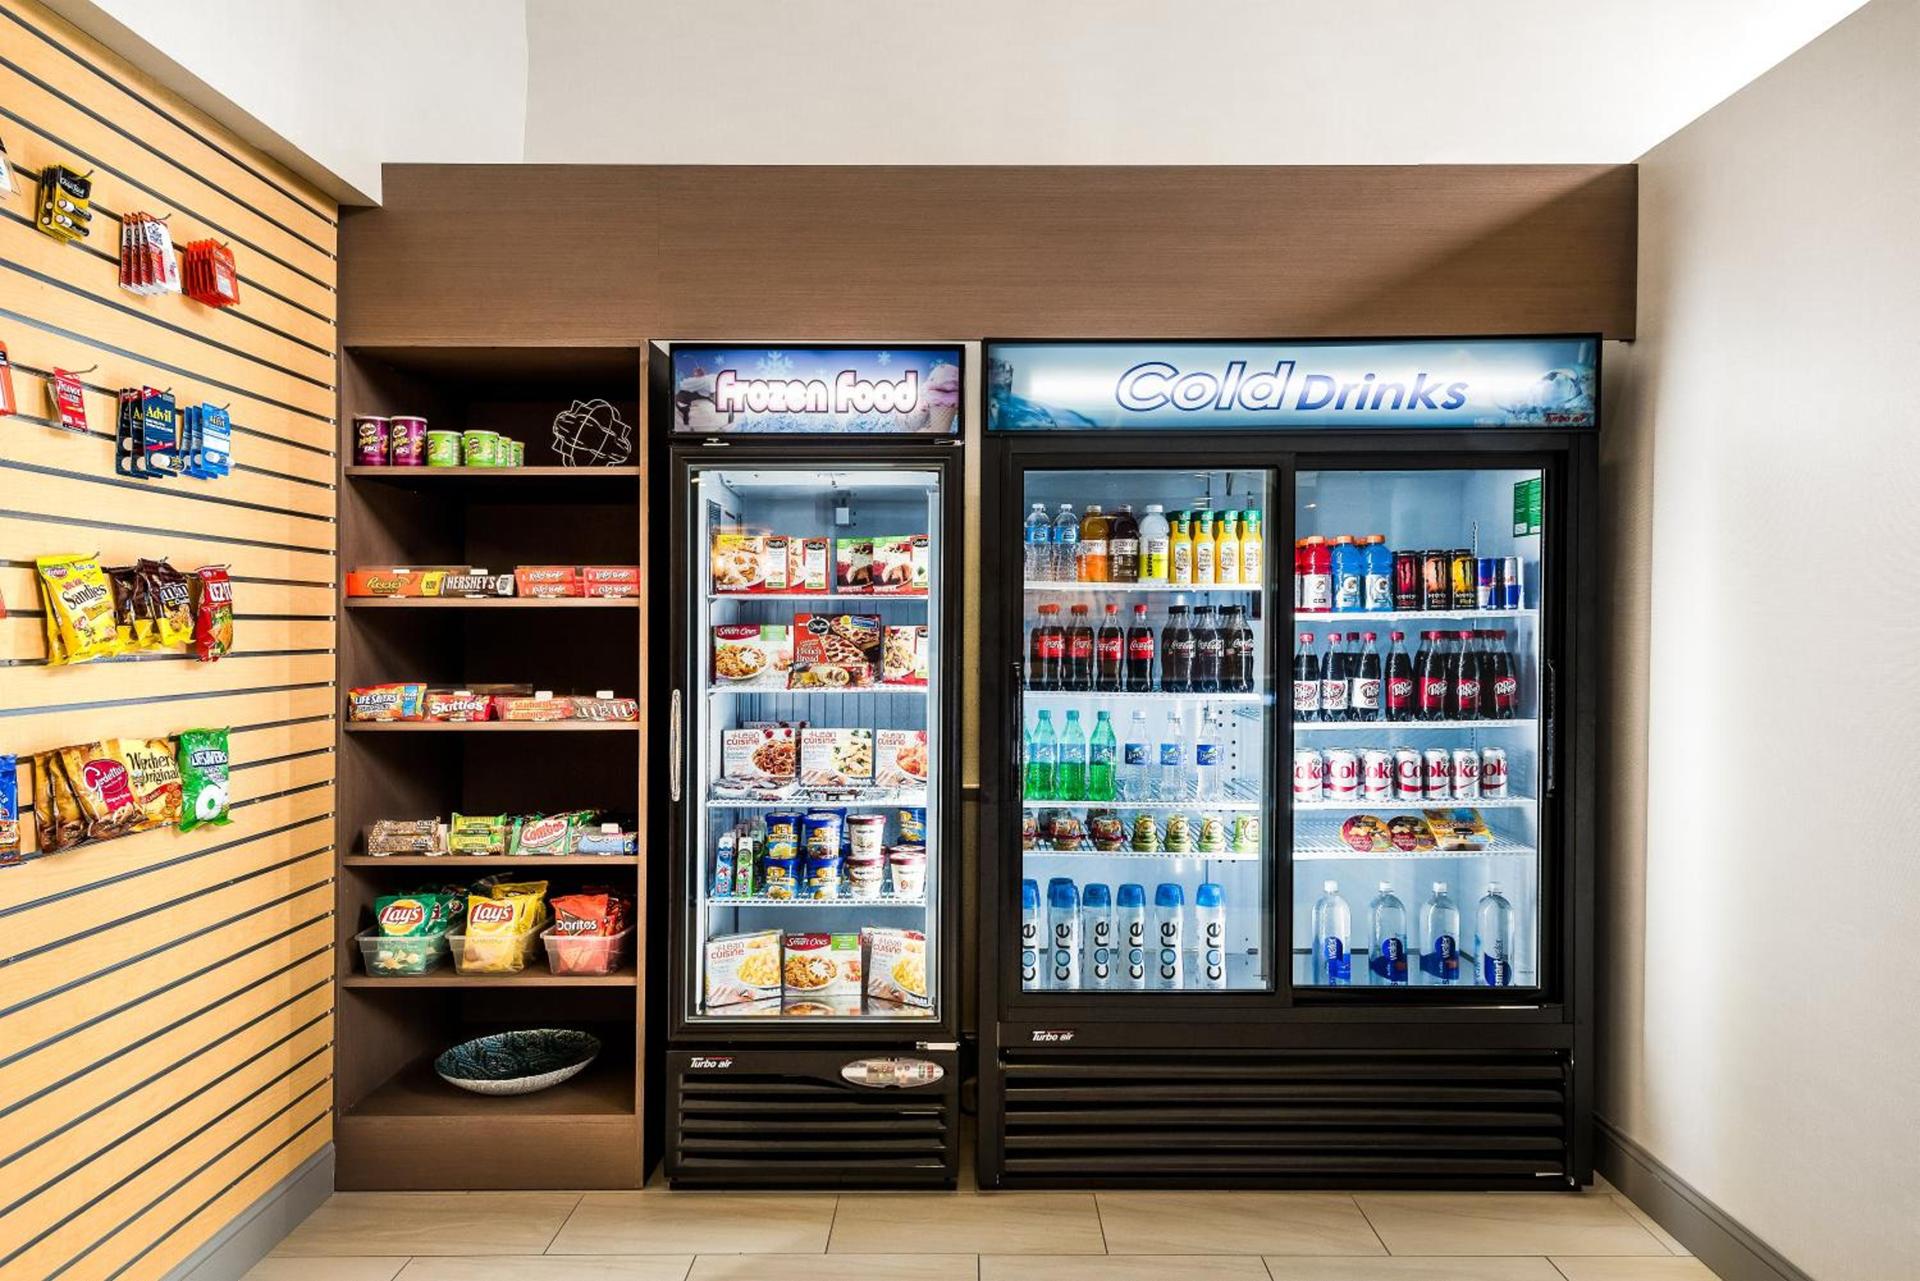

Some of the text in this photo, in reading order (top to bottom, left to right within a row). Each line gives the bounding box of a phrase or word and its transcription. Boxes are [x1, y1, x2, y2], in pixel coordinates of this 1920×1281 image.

[1114, 361, 1469, 412] Cold Drinks
[146, 405, 172, 422] Advil
[61, 585, 107, 610] Sandies
[447, 576, 494, 589] HERSHEY'S
[431, 700, 484, 715] Skittles
[556, 919, 598, 931] Doritos
[1023, 924, 1036, 981] core
[1055, 923, 1070, 980] core
[1094, 922, 1109, 978] core
[1129, 922, 1143, 979] core
[1160, 922, 1176, 979] core
[1206, 922, 1222, 980] core
[1032, 1030, 1075, 1041] Turbo air
[691, 1057, 732, 1068] Turbo air
